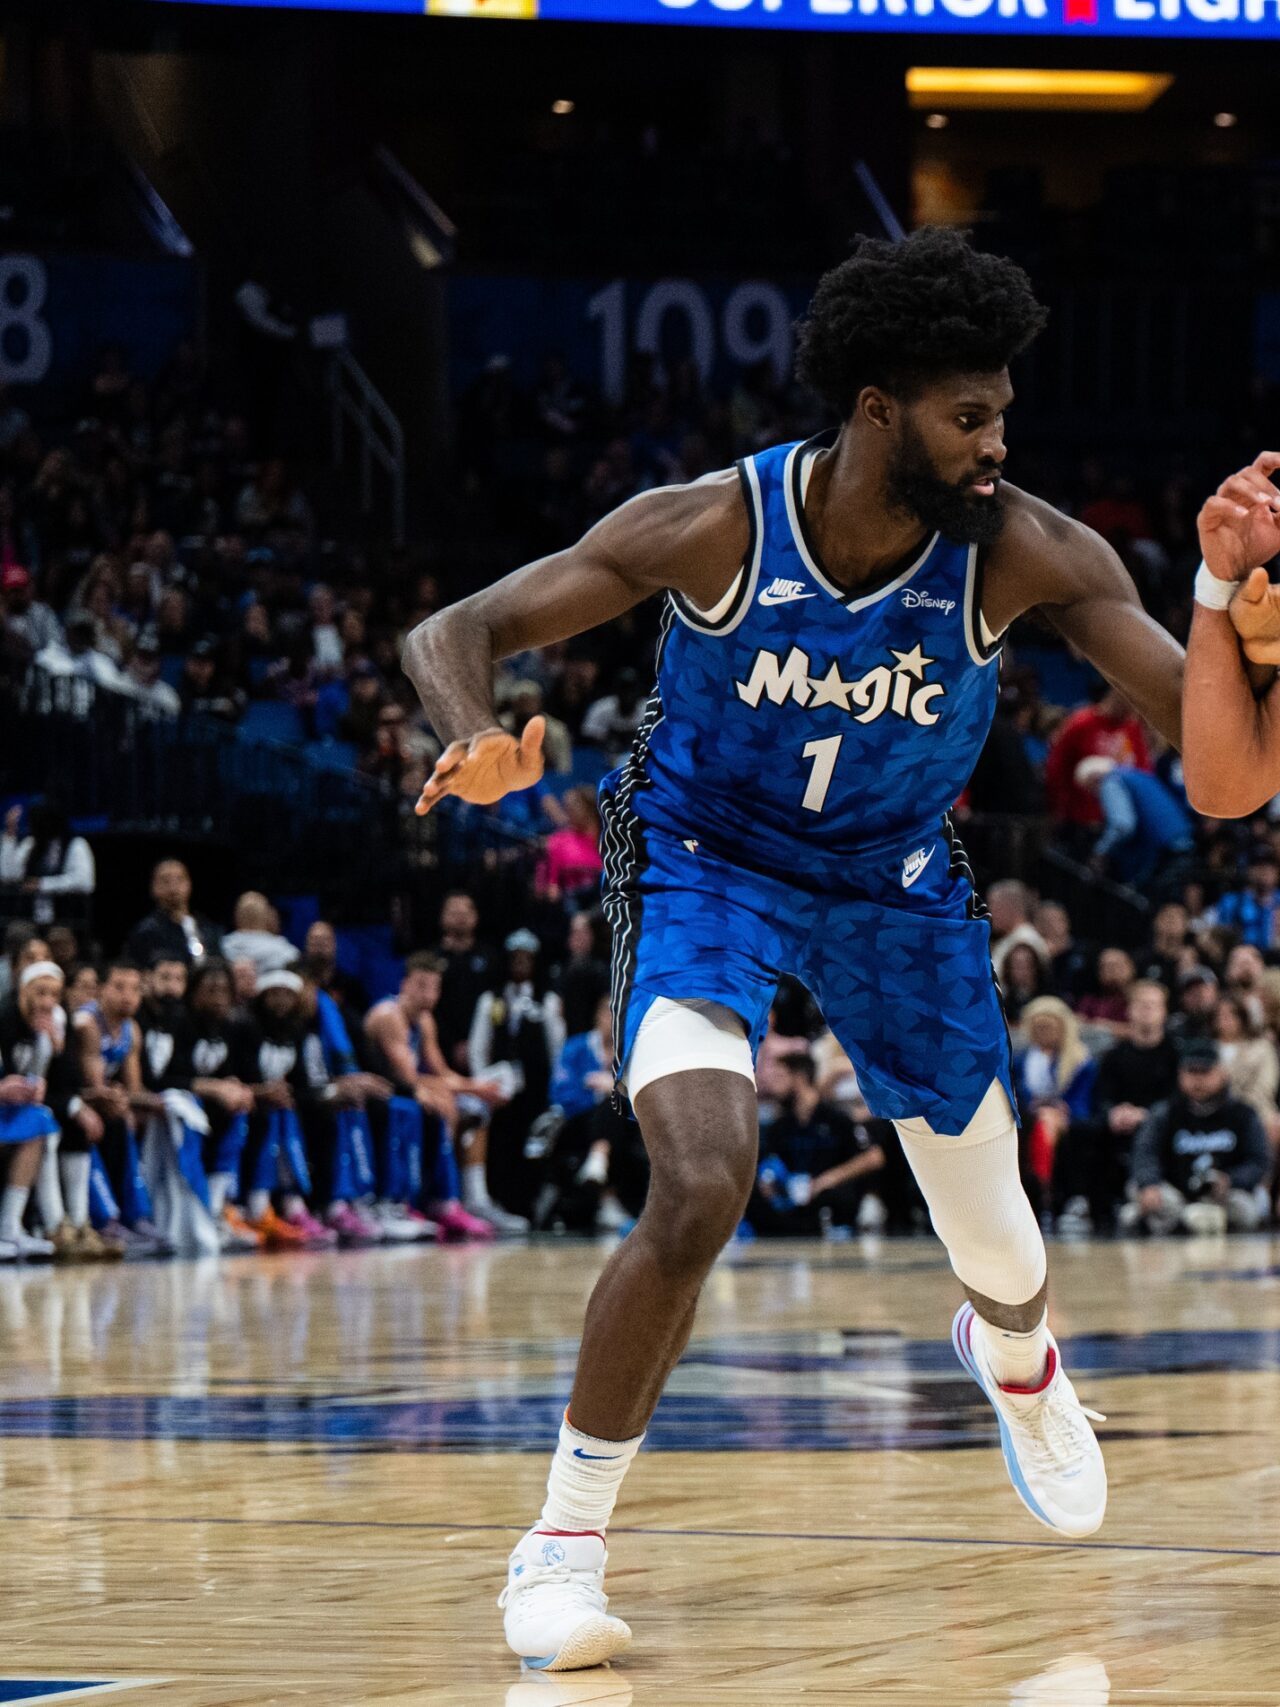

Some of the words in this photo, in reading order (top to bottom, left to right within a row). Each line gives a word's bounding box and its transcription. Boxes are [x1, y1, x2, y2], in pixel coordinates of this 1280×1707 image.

[587, 279, 793, 406] 109
[767, 577, 806, 597] NIKE
[900, 588, 956, 616] Disney
[801, 734, 843, 813] 1
